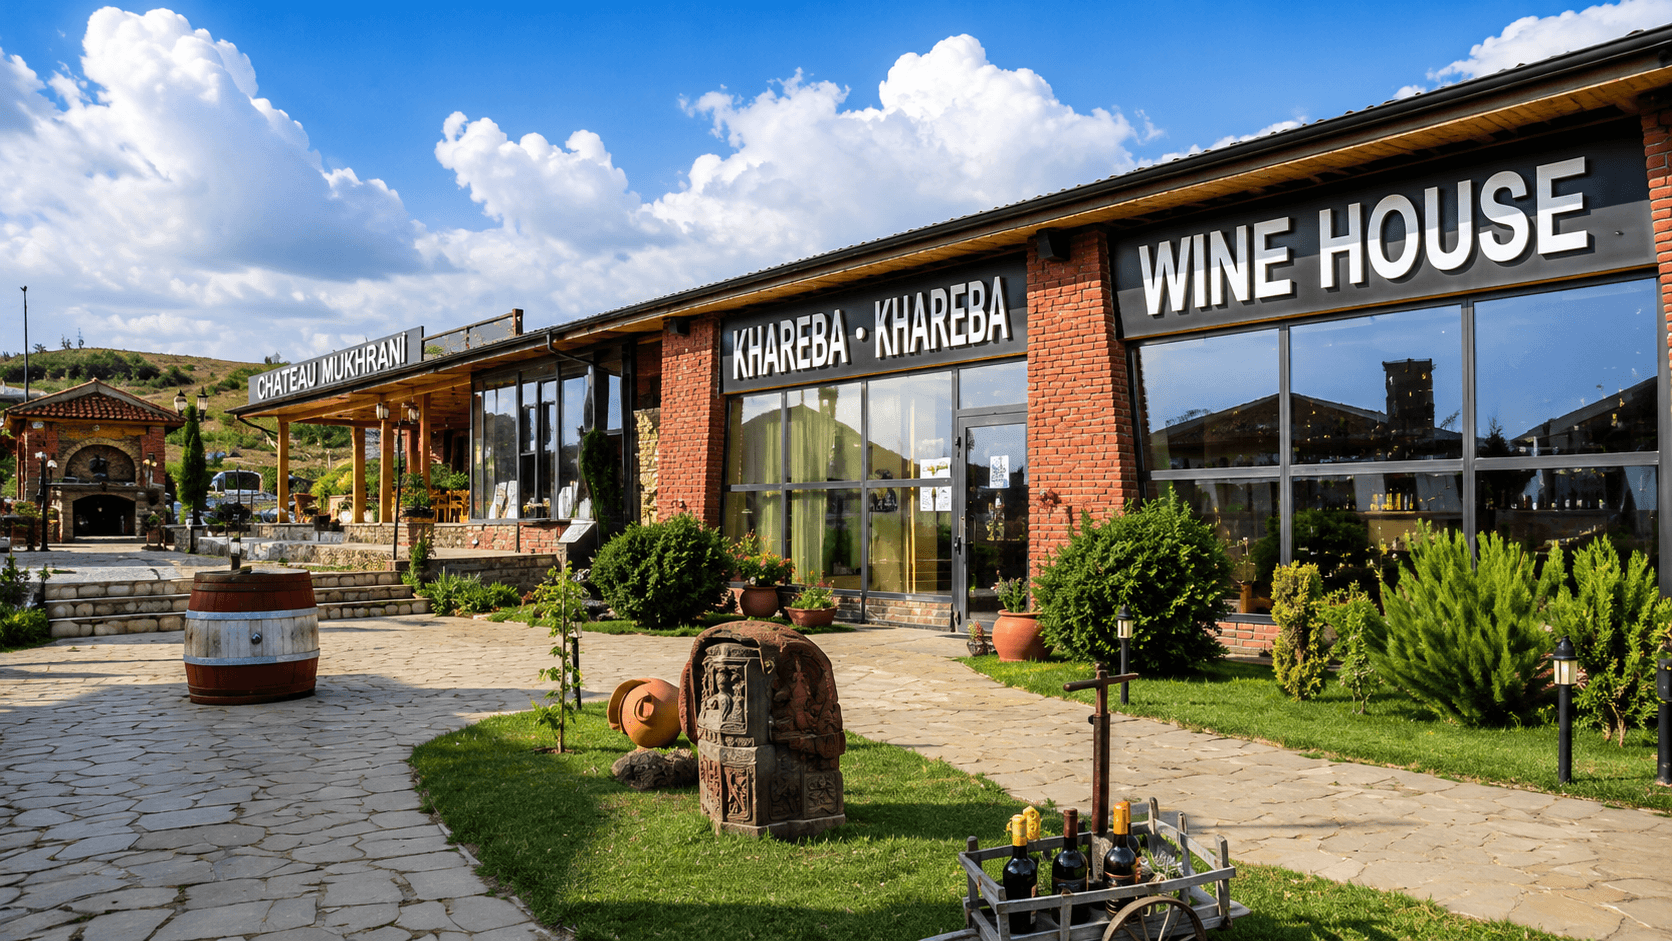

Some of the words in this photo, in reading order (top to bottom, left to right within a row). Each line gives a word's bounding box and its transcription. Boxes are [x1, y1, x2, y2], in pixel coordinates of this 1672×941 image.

[1138, 216, 1293, 316] WINE
[1318, 156, 1589, 289] HOUSE
[733, 309, 848, 380] KHAREBA
[875, 276, 1010, 358] KHAREBA
[257, 361, 317, 400] CHATEAU
